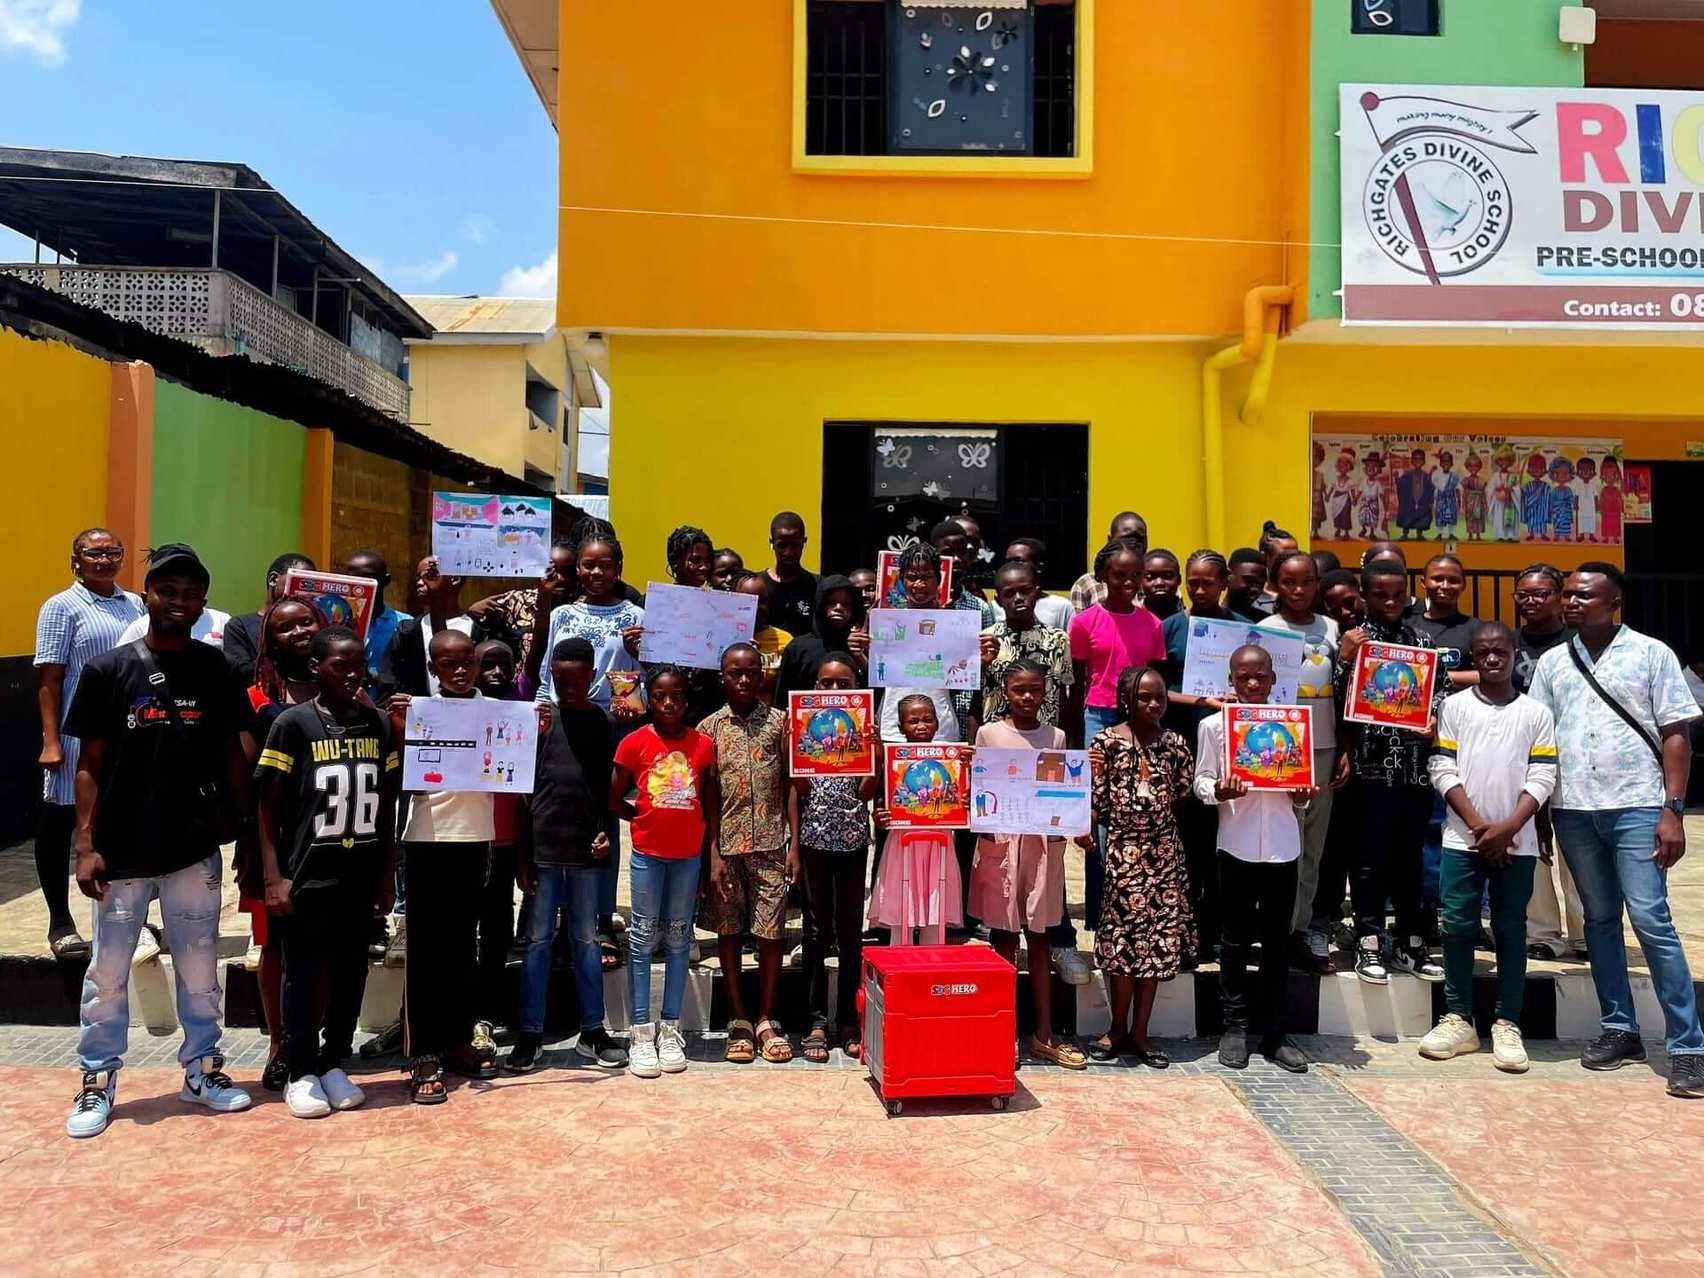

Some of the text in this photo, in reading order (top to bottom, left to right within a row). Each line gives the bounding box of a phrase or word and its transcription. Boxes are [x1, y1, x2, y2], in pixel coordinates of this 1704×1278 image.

[1370, 142, 1503, 264] RICHGATES DIVINE SCHOOL
[1563, 190, 1704, 234] DIV
[1536, 246, 1704, 268] PRE-SCHOO
[1564, 299, 1662, 317] Contact:
[1389, 649, 1415, 662] HERO
[821, 695, 849, 706] HERO
[1259, 709, 1286, 720] HERO
[311, 738, 380, 762] WU-TANG
[917, 747, 944, 757] HERO
[314, 763, 380, 838] 36
[951, 984, 977, 995] HERO
